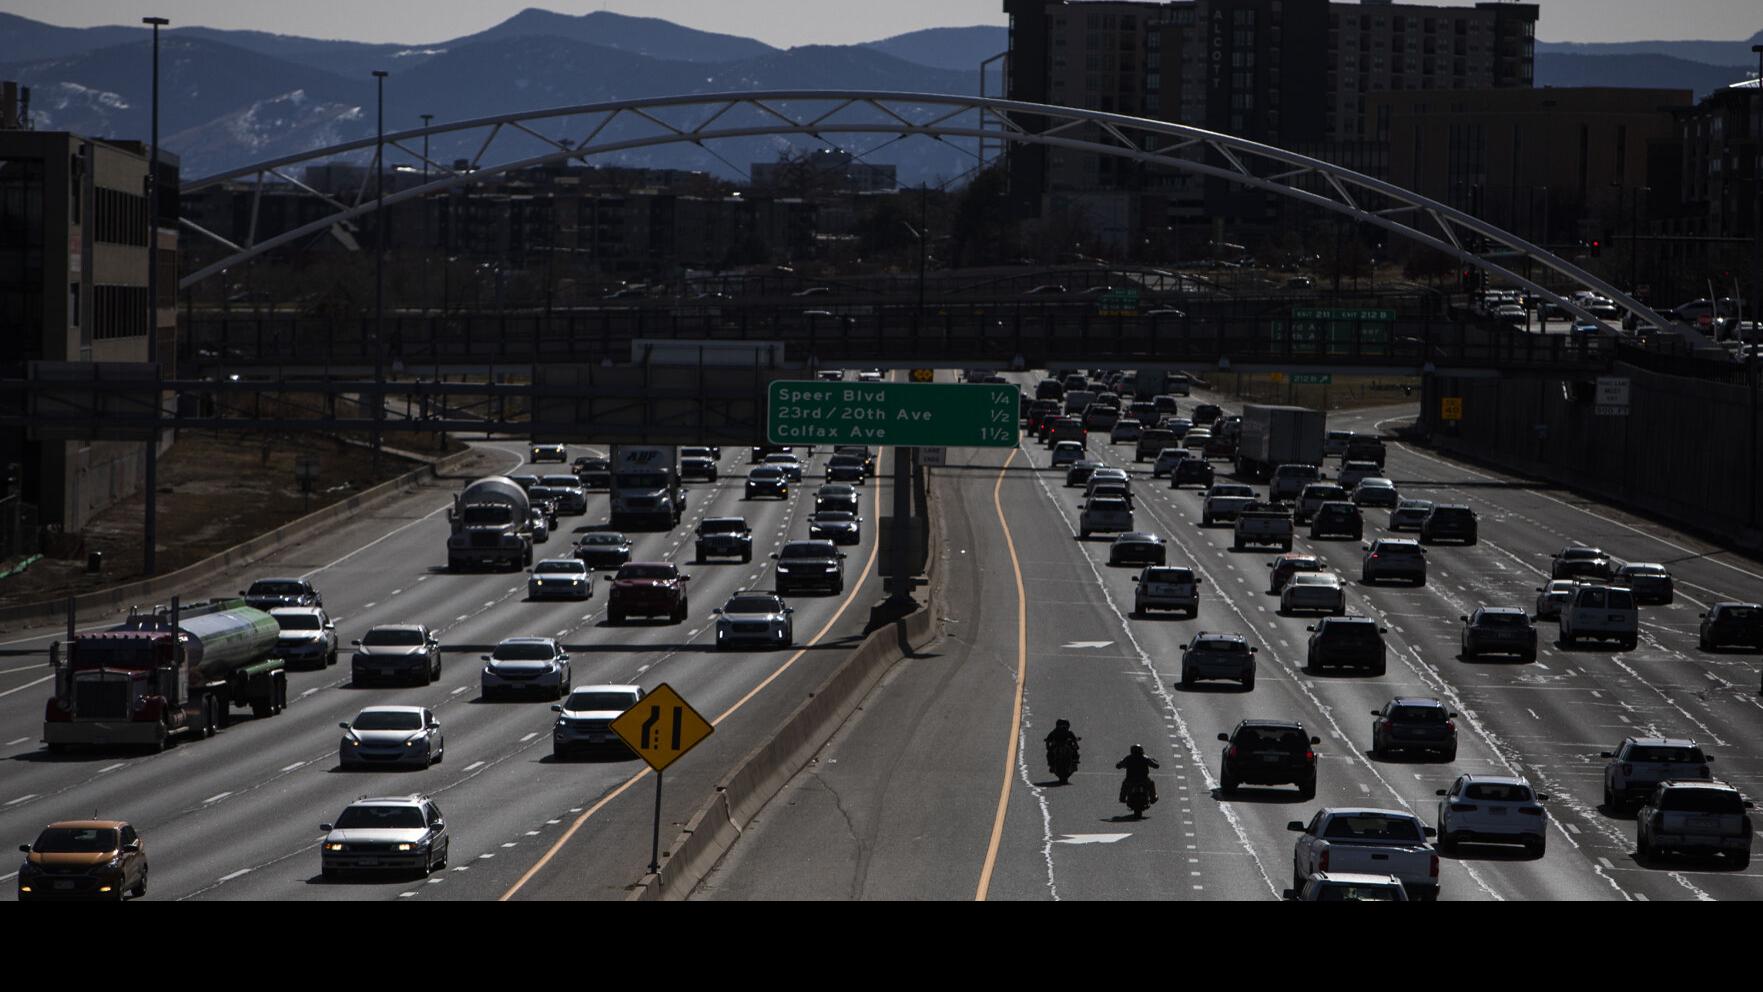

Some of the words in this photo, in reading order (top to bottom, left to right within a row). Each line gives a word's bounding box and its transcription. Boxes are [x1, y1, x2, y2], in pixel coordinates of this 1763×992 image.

[1212, 10, 1222, 88] ALCOTT
[1360, 310, 1378, 318] 212
[779, 388, 833, 403] Speer
[843, 389, 886, 402] Blvd
[896, 408, 932, 421] Ave
[777, 425, 838, 438] Colfax
[850, 425, 886, 438] Ave
